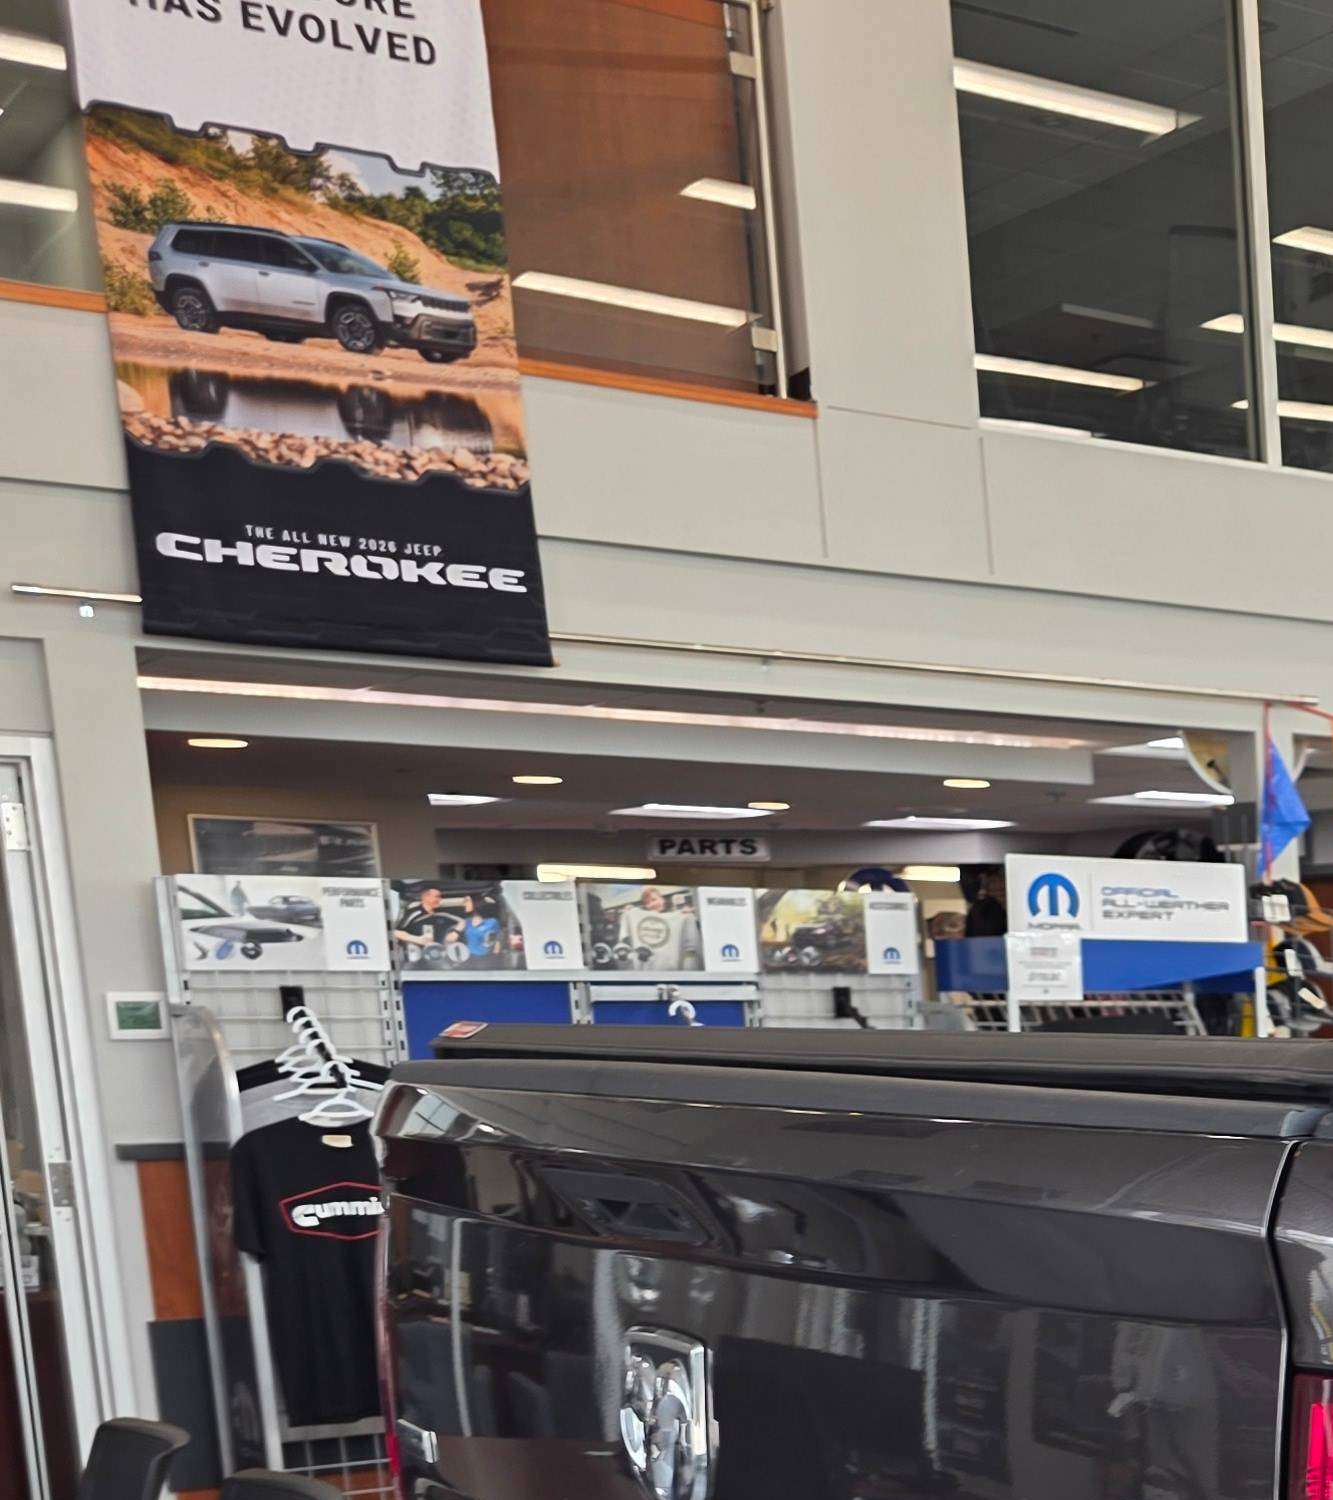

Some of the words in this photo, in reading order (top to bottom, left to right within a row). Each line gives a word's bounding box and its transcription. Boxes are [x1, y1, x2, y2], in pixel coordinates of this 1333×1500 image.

[241, 0, 437, 66] EVOLVED
[244, 524, 275, 540] THE
[282, 529, 312, 545] ALL
[318, 533, 352, 548] NEW
[404, 542, 443, 558] JEEP
[155, 532, 528, 593] CHEROKEE
[658, 838, 759, 856] PARTS
[291, 1196, 385, 1228] Cummi
